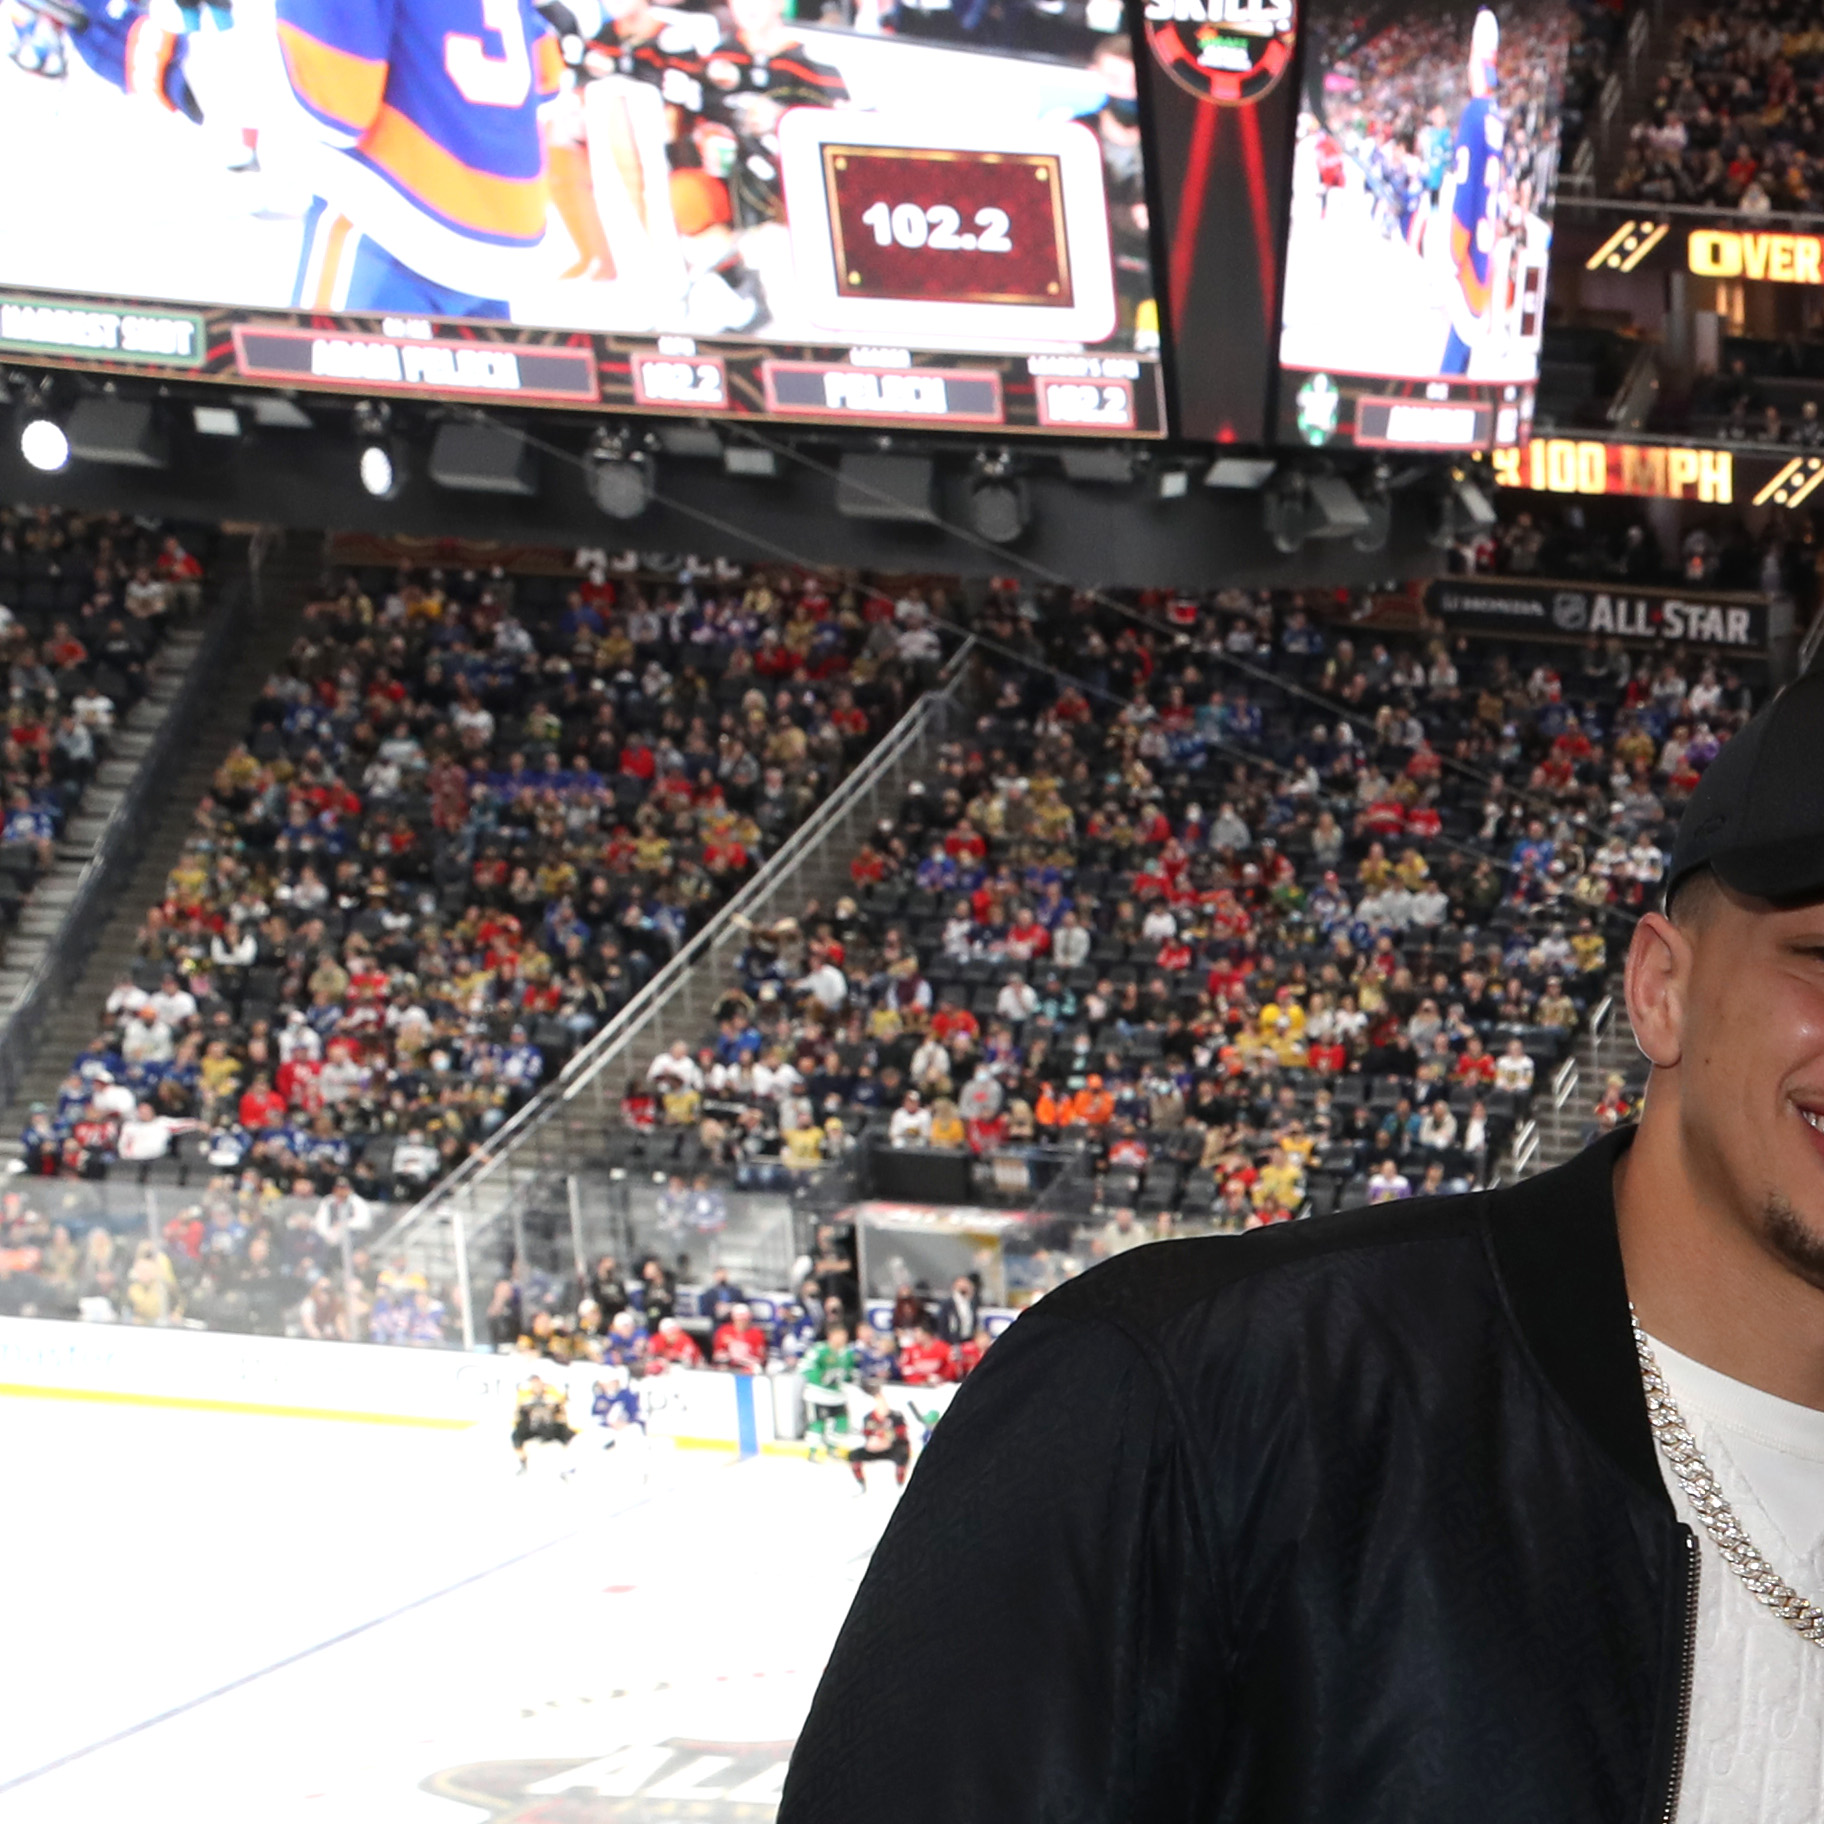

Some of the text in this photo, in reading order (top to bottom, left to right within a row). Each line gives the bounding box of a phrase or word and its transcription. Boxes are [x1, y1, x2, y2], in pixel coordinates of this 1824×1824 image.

[862, 202, 1012, 253] 102.2
[1688, 230, 1823, 284] OVER
[1530, 439, 1607, 494] 100
[1620, 446, 1733, 504] MPH
[1590, 595, 1657, 637] ALL
[1661, 600, 1750, 645] STAR
